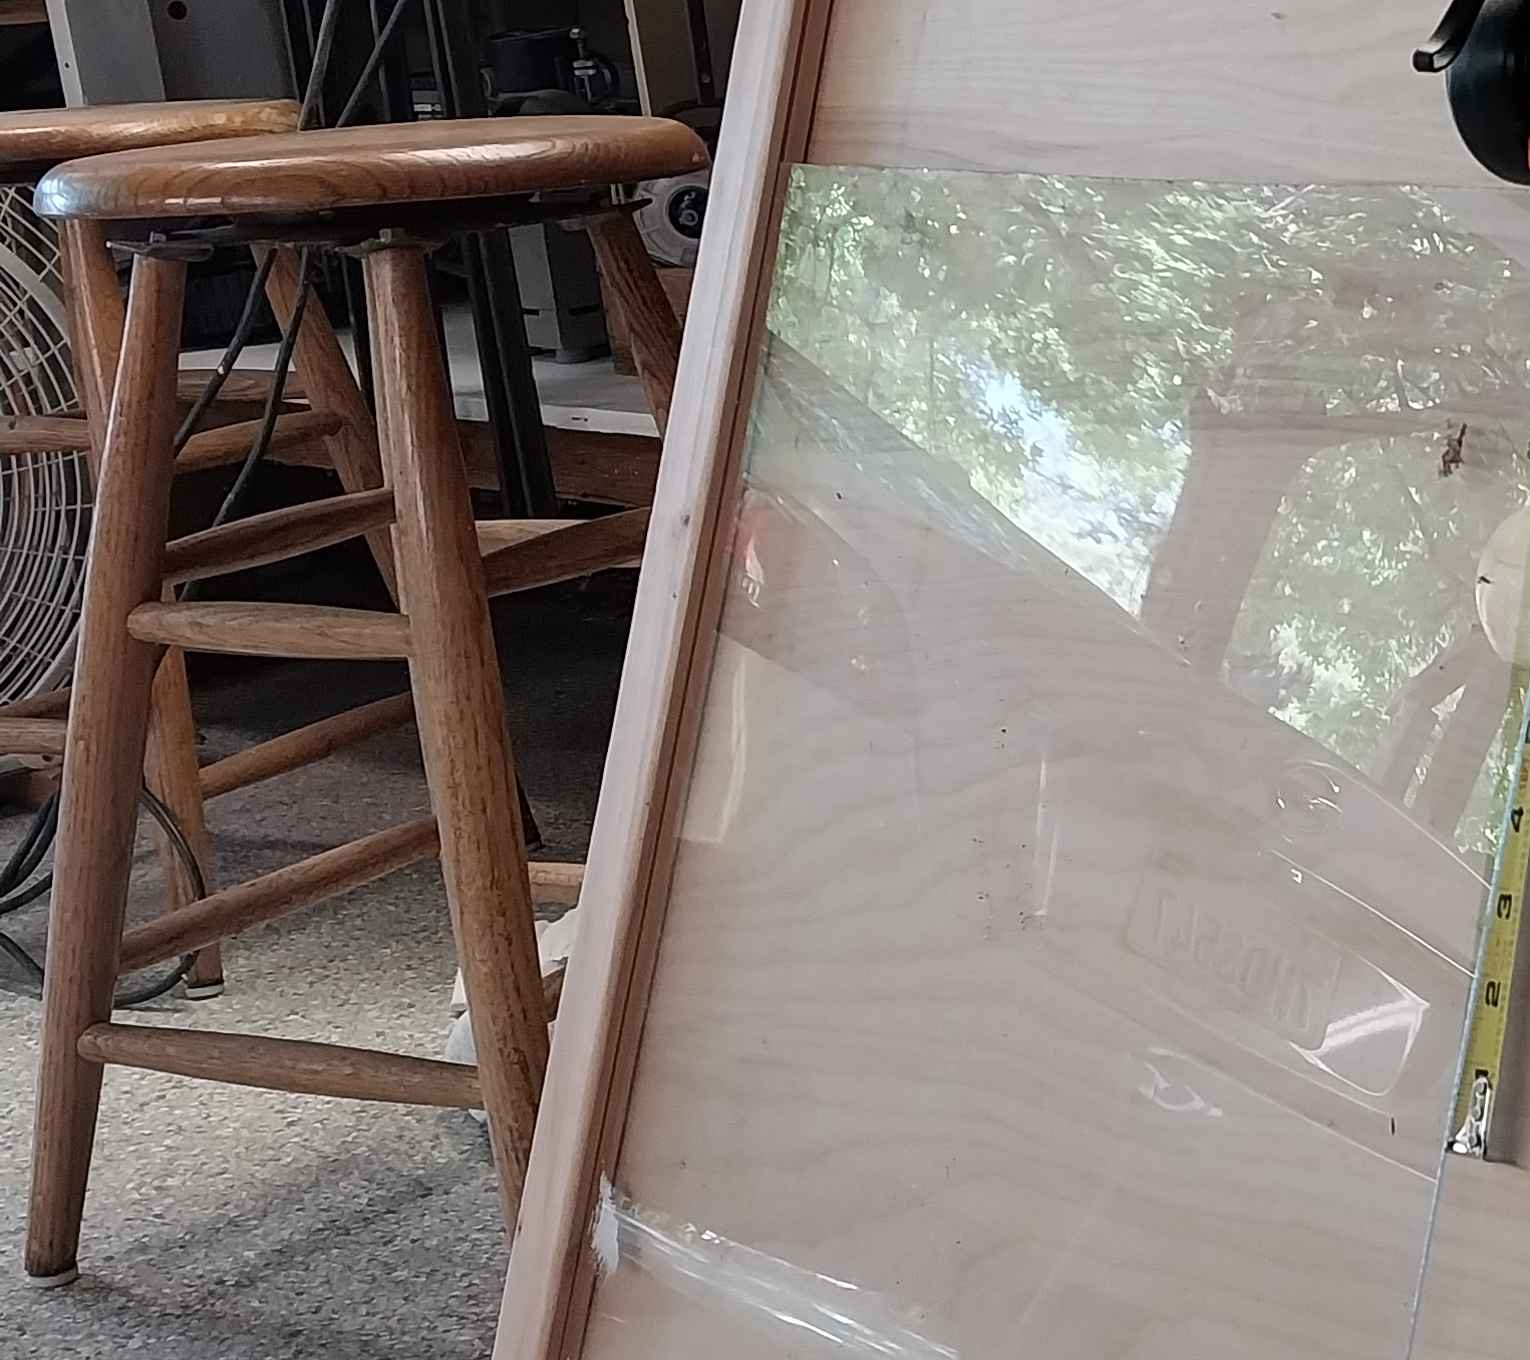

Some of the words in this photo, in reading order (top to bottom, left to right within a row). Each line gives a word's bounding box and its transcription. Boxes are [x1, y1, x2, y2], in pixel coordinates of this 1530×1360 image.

[1484, 981, 1501, 1008] 2
[1497, 894, 1512, 920] 3
[1510, 806, 1526, 834] 4
